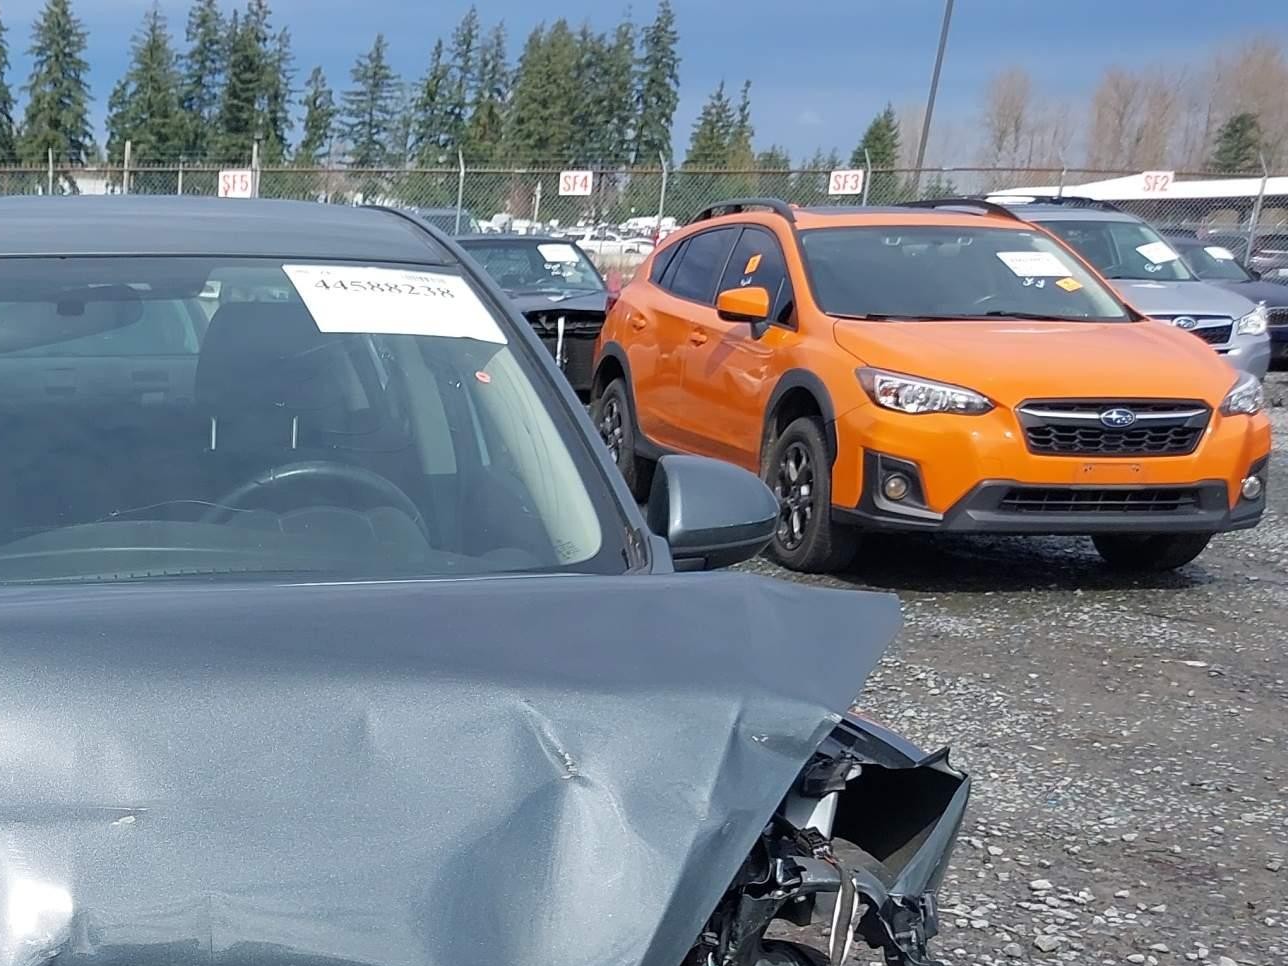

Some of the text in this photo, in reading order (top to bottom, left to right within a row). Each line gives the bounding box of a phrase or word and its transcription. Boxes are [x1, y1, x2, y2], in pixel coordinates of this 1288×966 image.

[222, 174, 249, 192] SF5
[562, 174, 589, 193] SF4
[832, 174, 860, 192] SF3
[1143, 174, 1169, 193] SF2
[314, 278, 456, 299] 44588238
